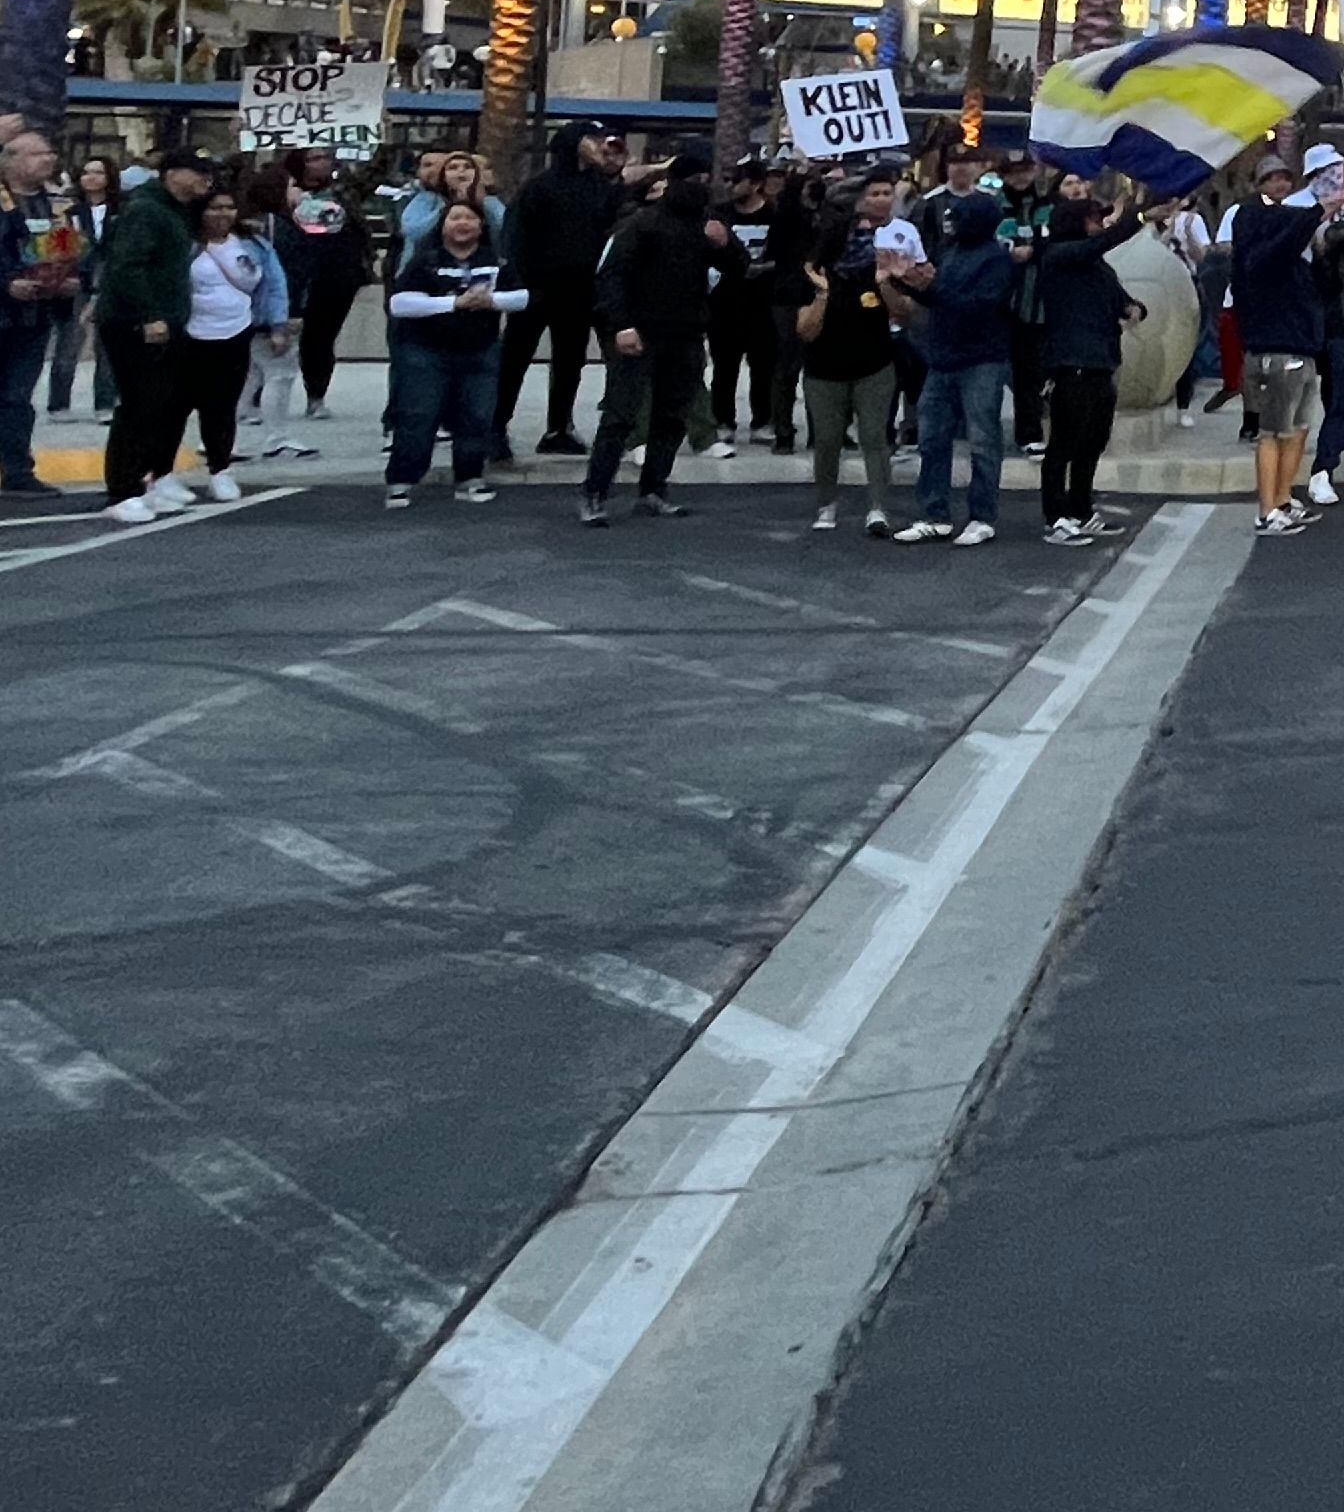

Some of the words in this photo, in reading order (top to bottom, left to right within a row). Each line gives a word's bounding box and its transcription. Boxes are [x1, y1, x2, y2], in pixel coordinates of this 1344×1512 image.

[253, 65, 344, 97] STOP
[800, 78, 884, 117] KLEIN
[243, 100, 338, 131] DECADE
[822, 108, 894, 146] OUT!
